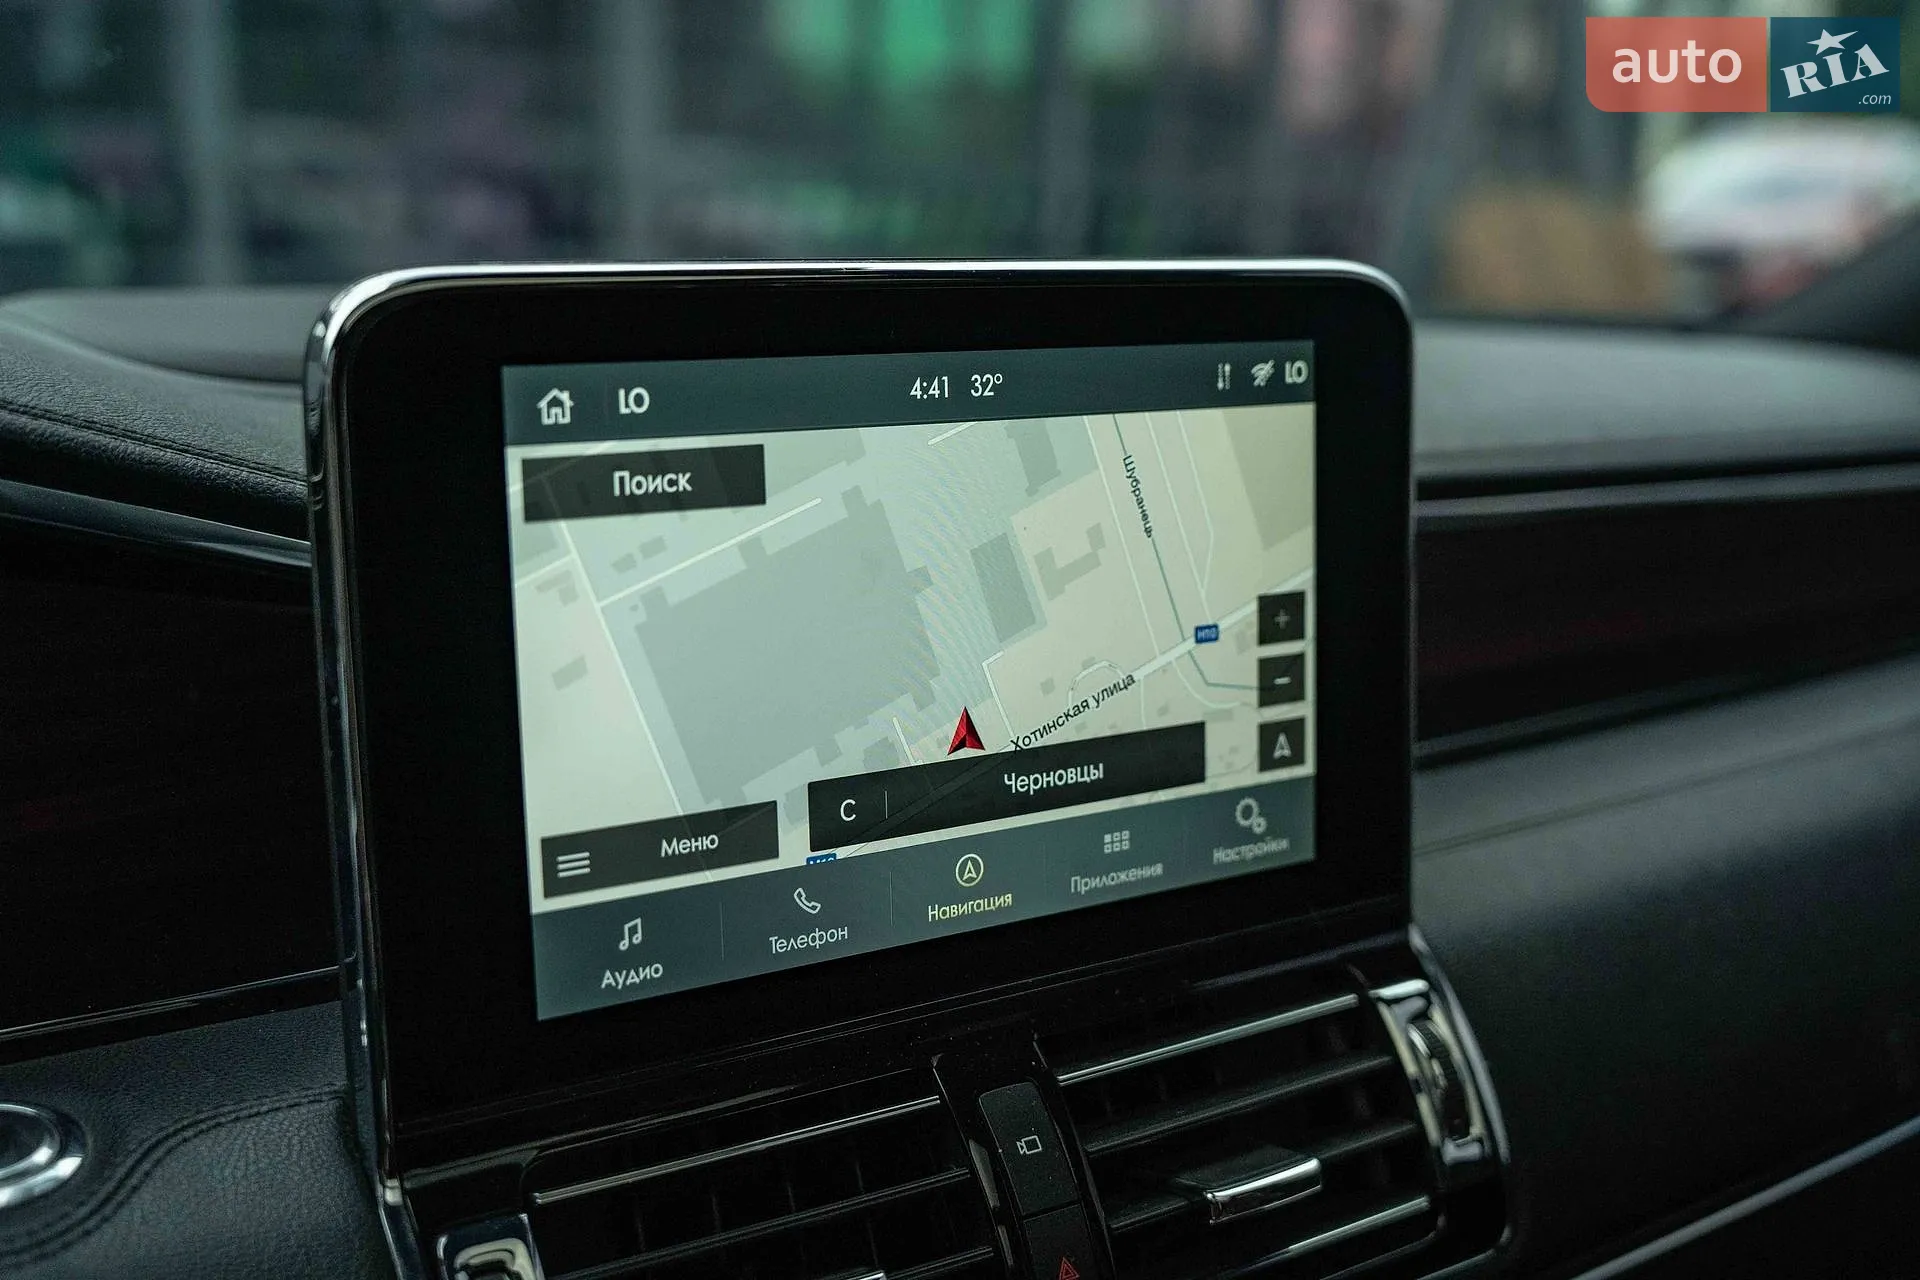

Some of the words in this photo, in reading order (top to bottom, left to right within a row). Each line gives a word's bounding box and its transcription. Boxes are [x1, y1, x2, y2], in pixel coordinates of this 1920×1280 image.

[617, 387, 651, 414] LO
[909, 376, 950, 399] 4:41
[612, 470, 692, 497] Поиск
[1010, 698, 1091, 752] Хотинская
[1090, 672, 1137, 711] улица
[1003, 761, 1105, 796] Черновцы
[660, 833, 719, 858] Меню
[1212, 836, 1290, 863] Настройки
[1070, 862, 1164, 895] Приложения
[927, 892, 1013, 922] Навигация
[769, 925, 849, 955] Телефон
[601, 963, 664, 990] Аудио
